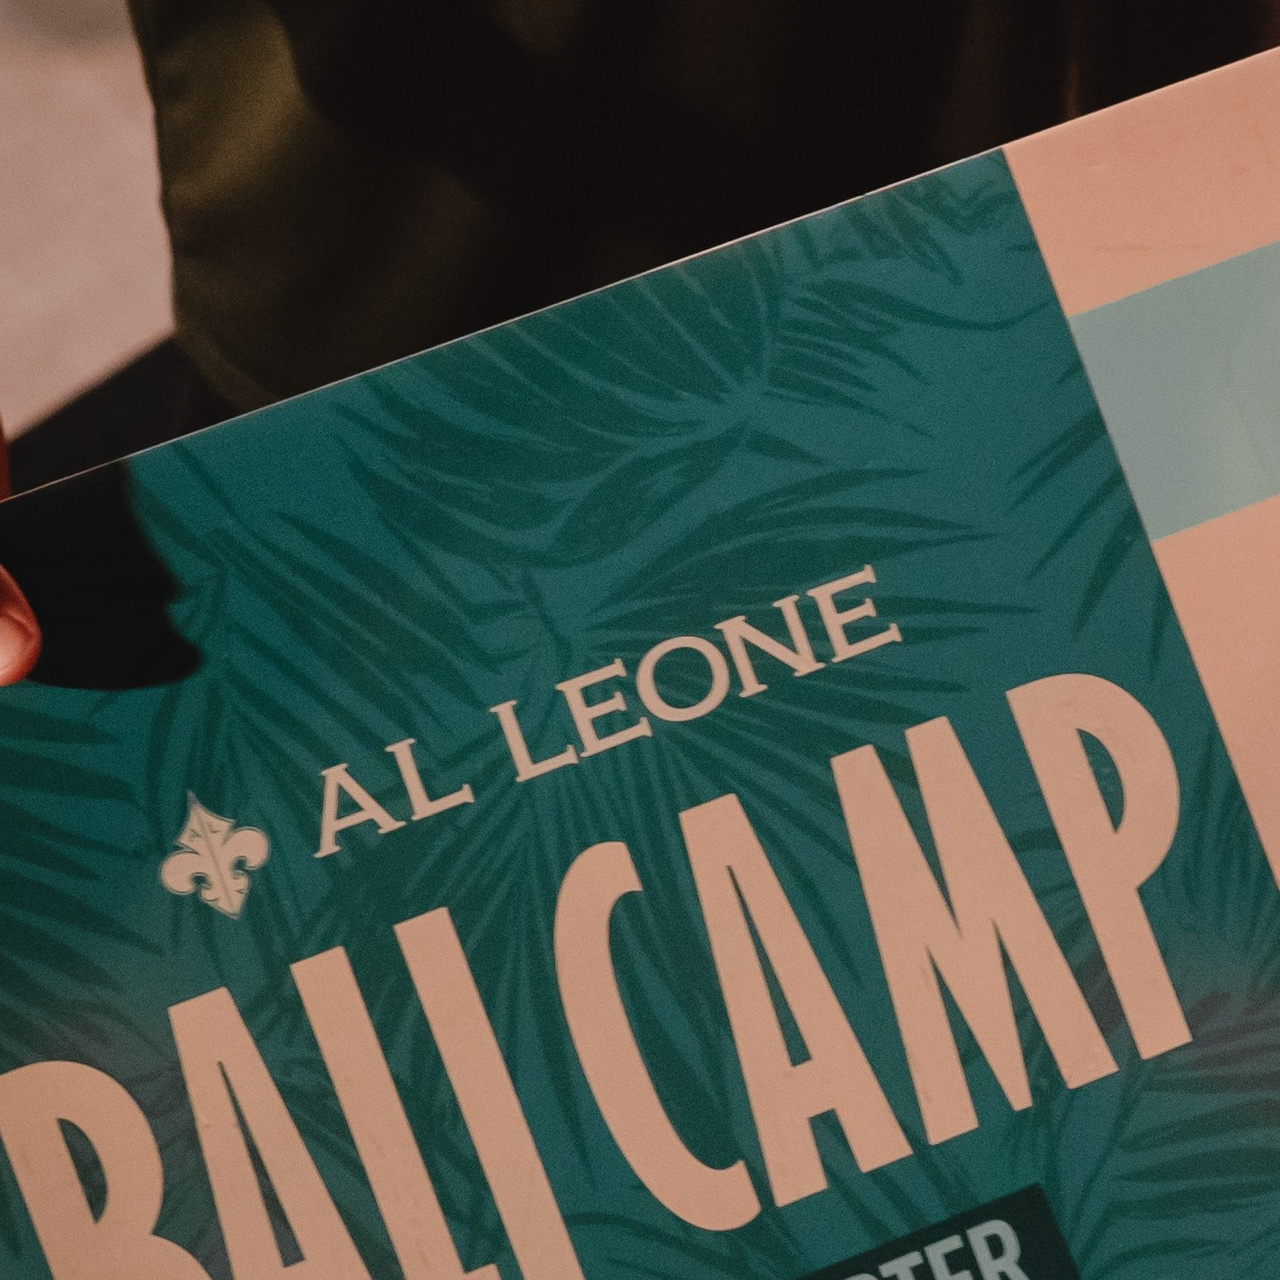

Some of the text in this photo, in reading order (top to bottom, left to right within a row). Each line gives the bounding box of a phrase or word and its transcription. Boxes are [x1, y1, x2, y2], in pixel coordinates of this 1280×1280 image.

[312, 564, 902, 859] AL LEONE
[553, 673, 1194, 1231] CAMP
